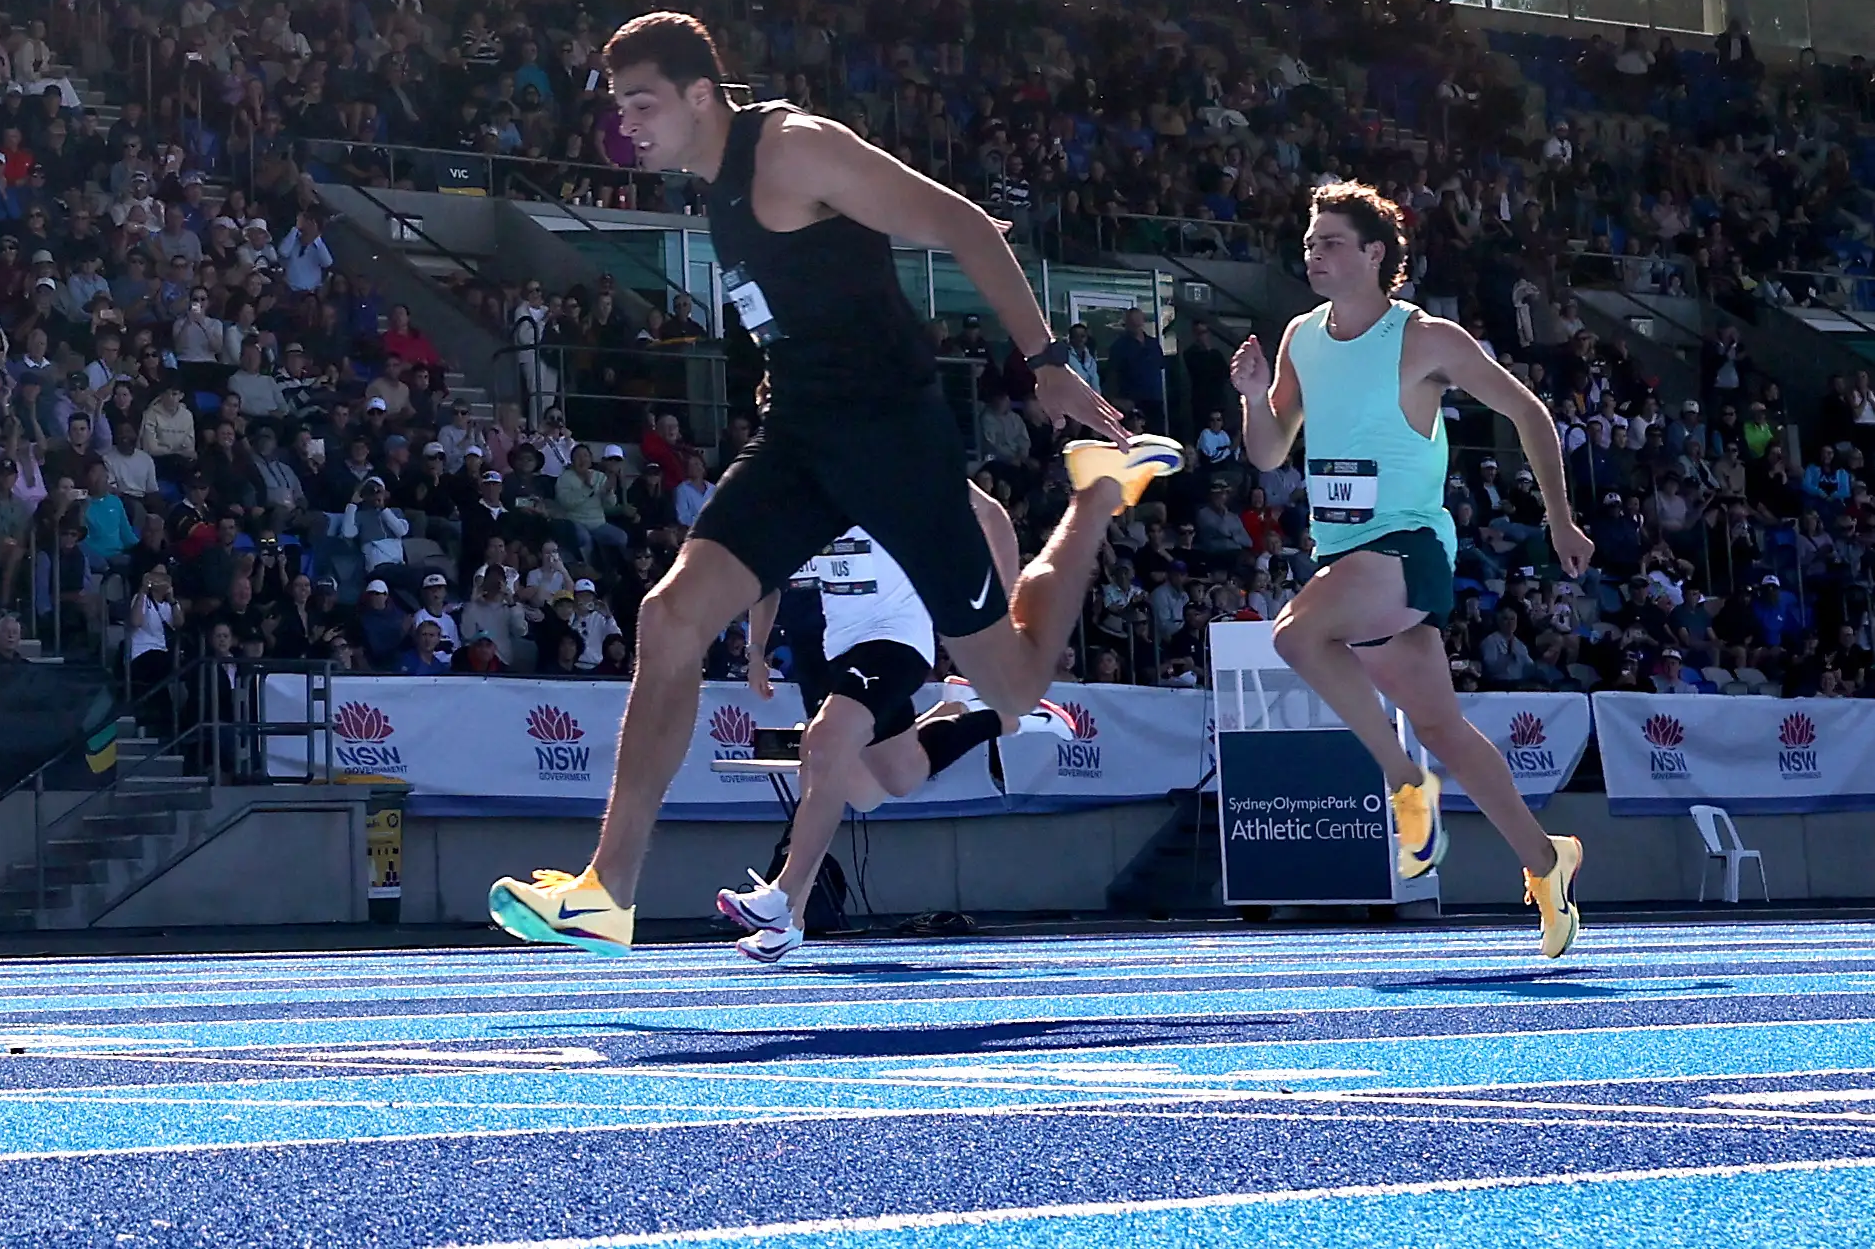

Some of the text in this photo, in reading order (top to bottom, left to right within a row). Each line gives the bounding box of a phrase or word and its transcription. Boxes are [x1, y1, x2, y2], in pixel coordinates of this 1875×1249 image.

[449, 167, 470, 180] VIC
[1327, 482, 1353, 502] LAW
[335, 746, 401, 766] NSW
[534, 746, 590, 772] NSW
[1057, 743, 1100, 769] NSW
[1506, 750, 1555, 771] NSW
[1650, 750, 1688, 772] NSW
[1778, 750, 1817, 772] NSW
[538, 772, 591, 782] GOVERNMENT
[1228, 795, 1358, 812] SydneyOlympicPark
[1230, 817, 1383, 841] Athletic Centre
